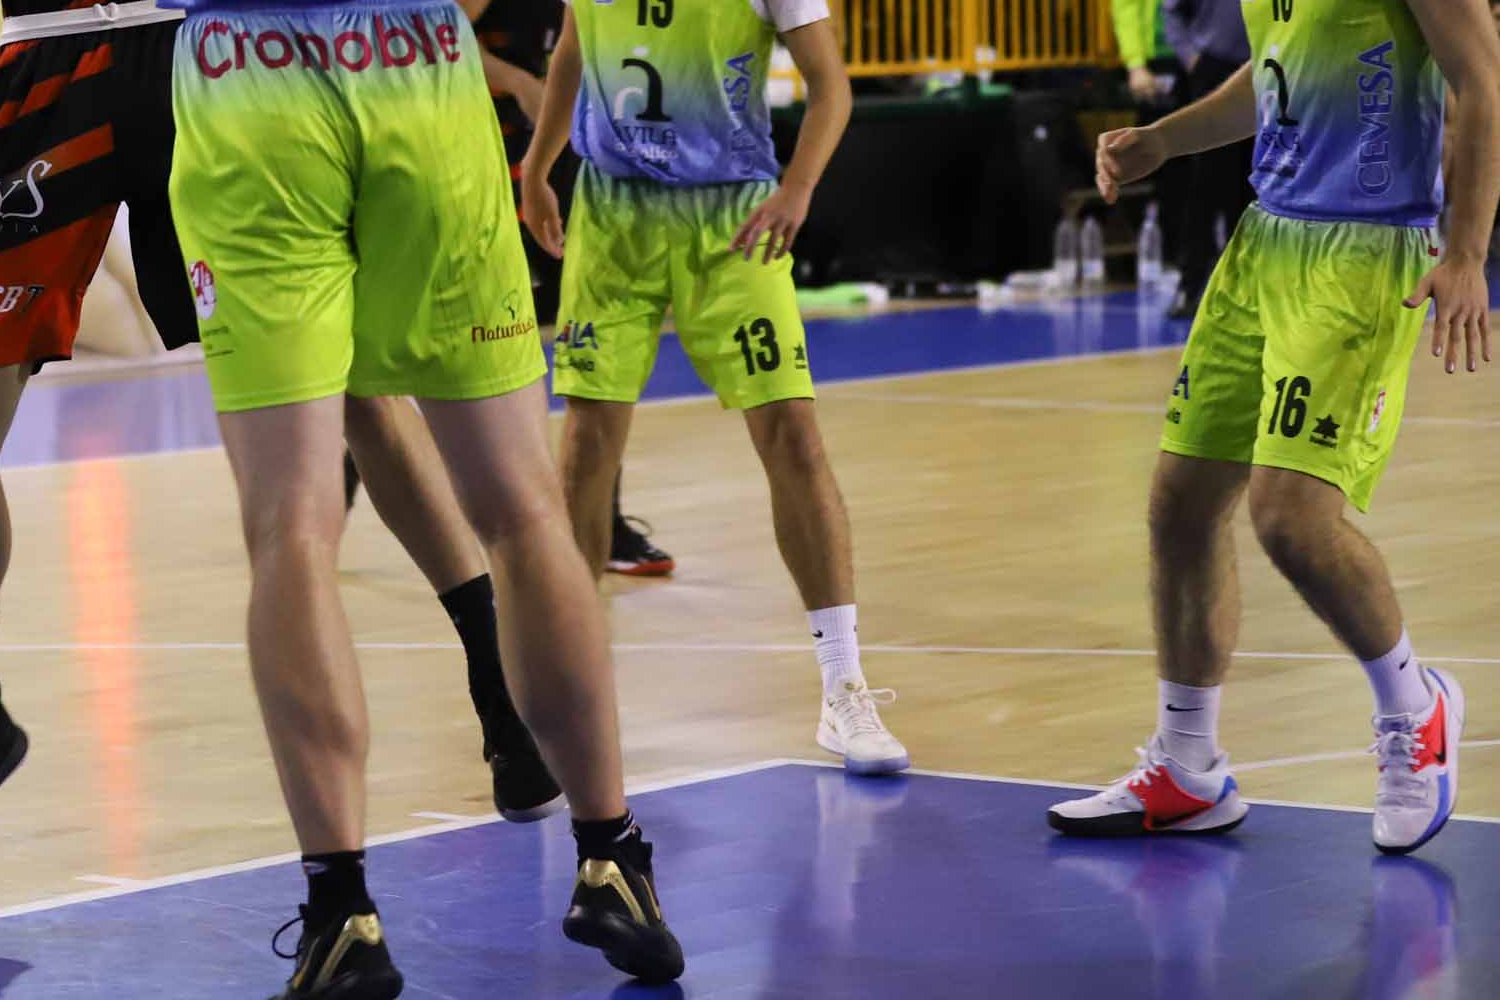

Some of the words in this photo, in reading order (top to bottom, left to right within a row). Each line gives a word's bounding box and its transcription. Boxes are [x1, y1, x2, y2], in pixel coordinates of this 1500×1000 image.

[198, 13, 461, 79] Cronoble
[1356, 40, 1394, 197] CEVESA
[733, 317, 781, 376] 13
[1267, 375, 1312, 438] 16
